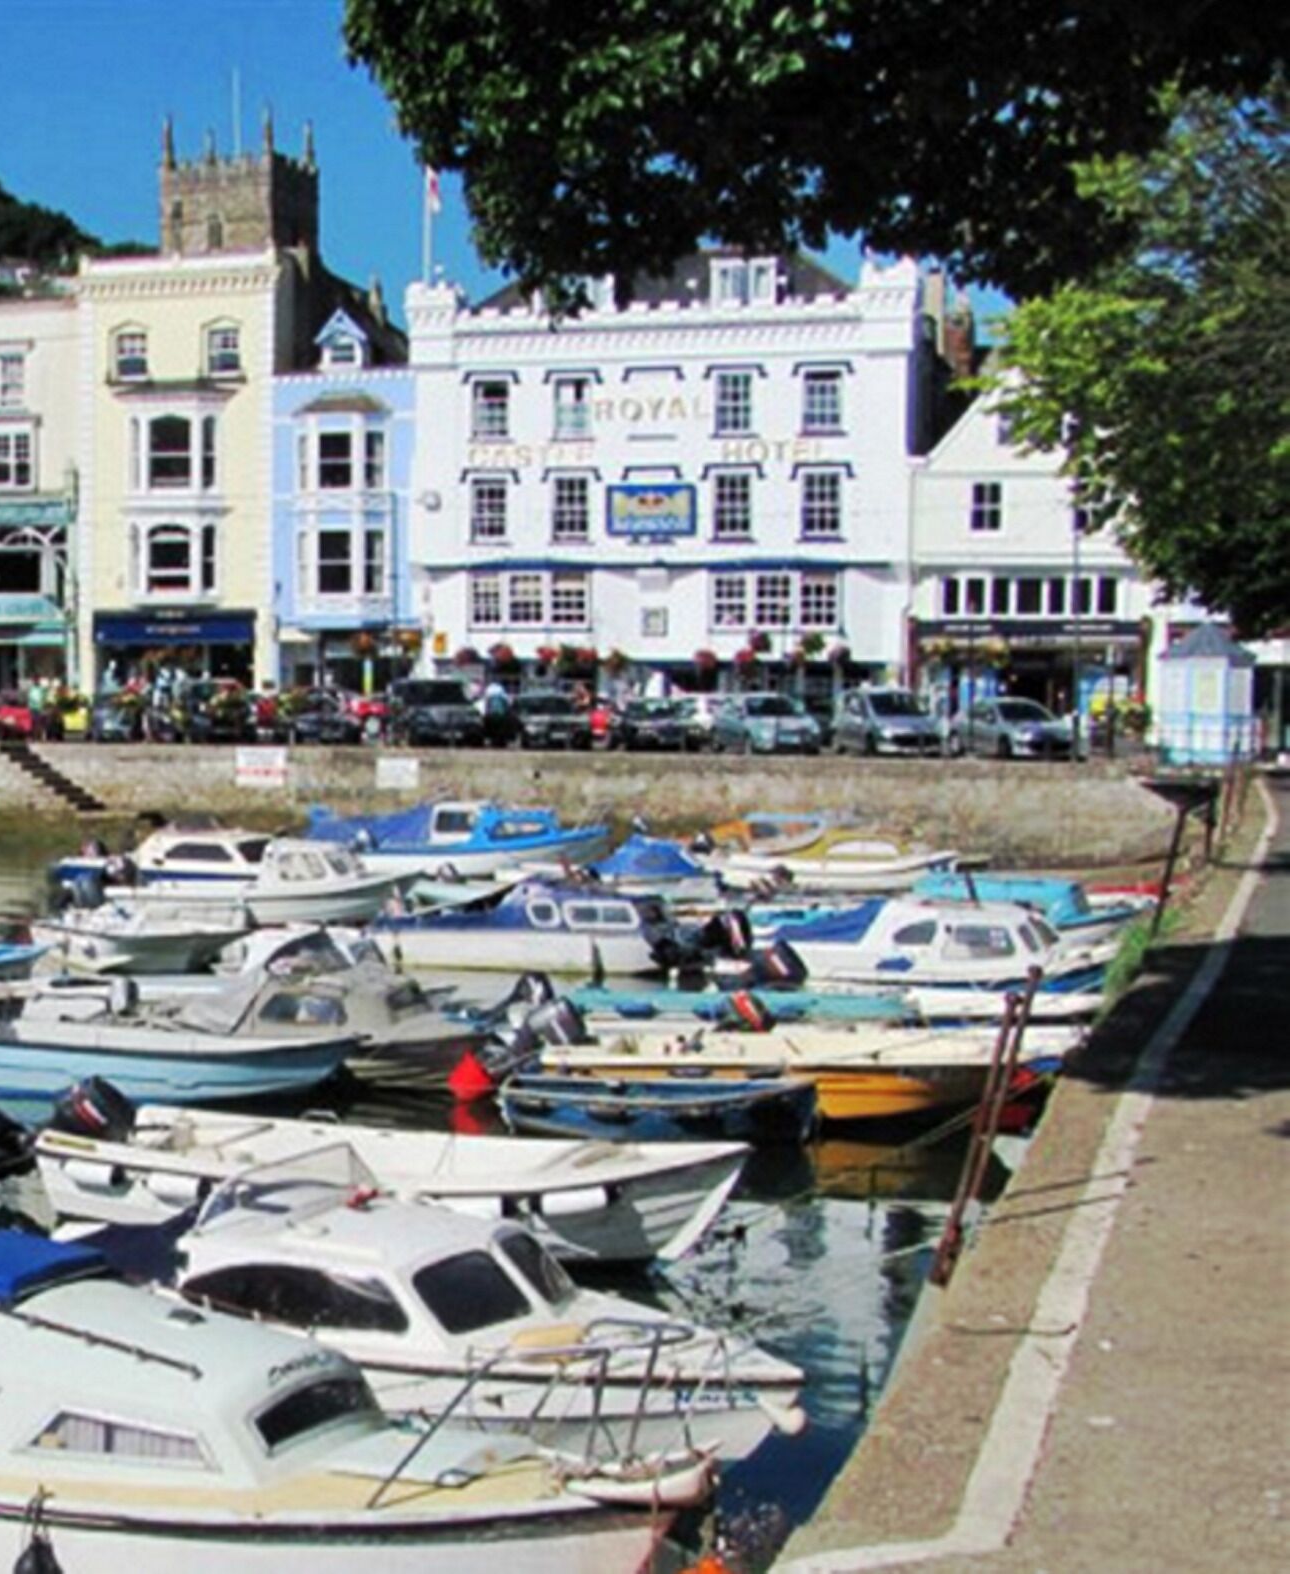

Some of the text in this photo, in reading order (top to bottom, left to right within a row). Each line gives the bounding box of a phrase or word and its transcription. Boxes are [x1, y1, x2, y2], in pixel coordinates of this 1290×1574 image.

[595, 397, 711, 422] ROYAL
[468, 439, 832, 467] CASTLE HOTEL
